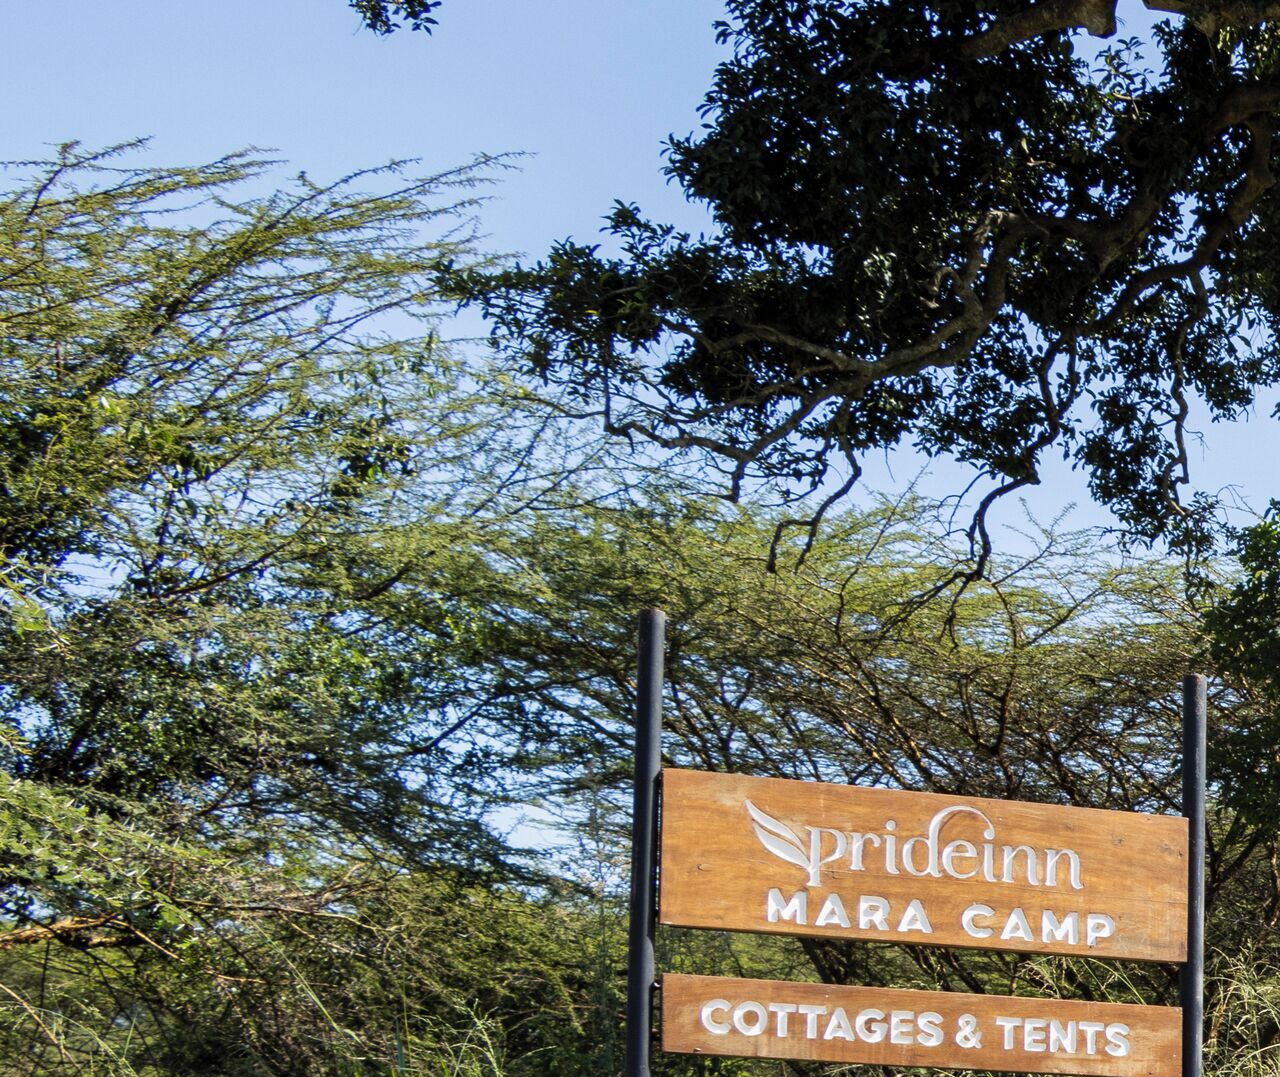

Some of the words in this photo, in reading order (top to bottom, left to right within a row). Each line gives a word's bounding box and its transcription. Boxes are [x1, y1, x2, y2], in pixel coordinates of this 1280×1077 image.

[766, 887, 932, 933] MARA
[960, 903, 1117, 947] CAMP
[699, 999, 944, 1047] COTTAGES
[955, 1014, 982, 1048] &
[995, 1016, 1133, 1058] TENTS
